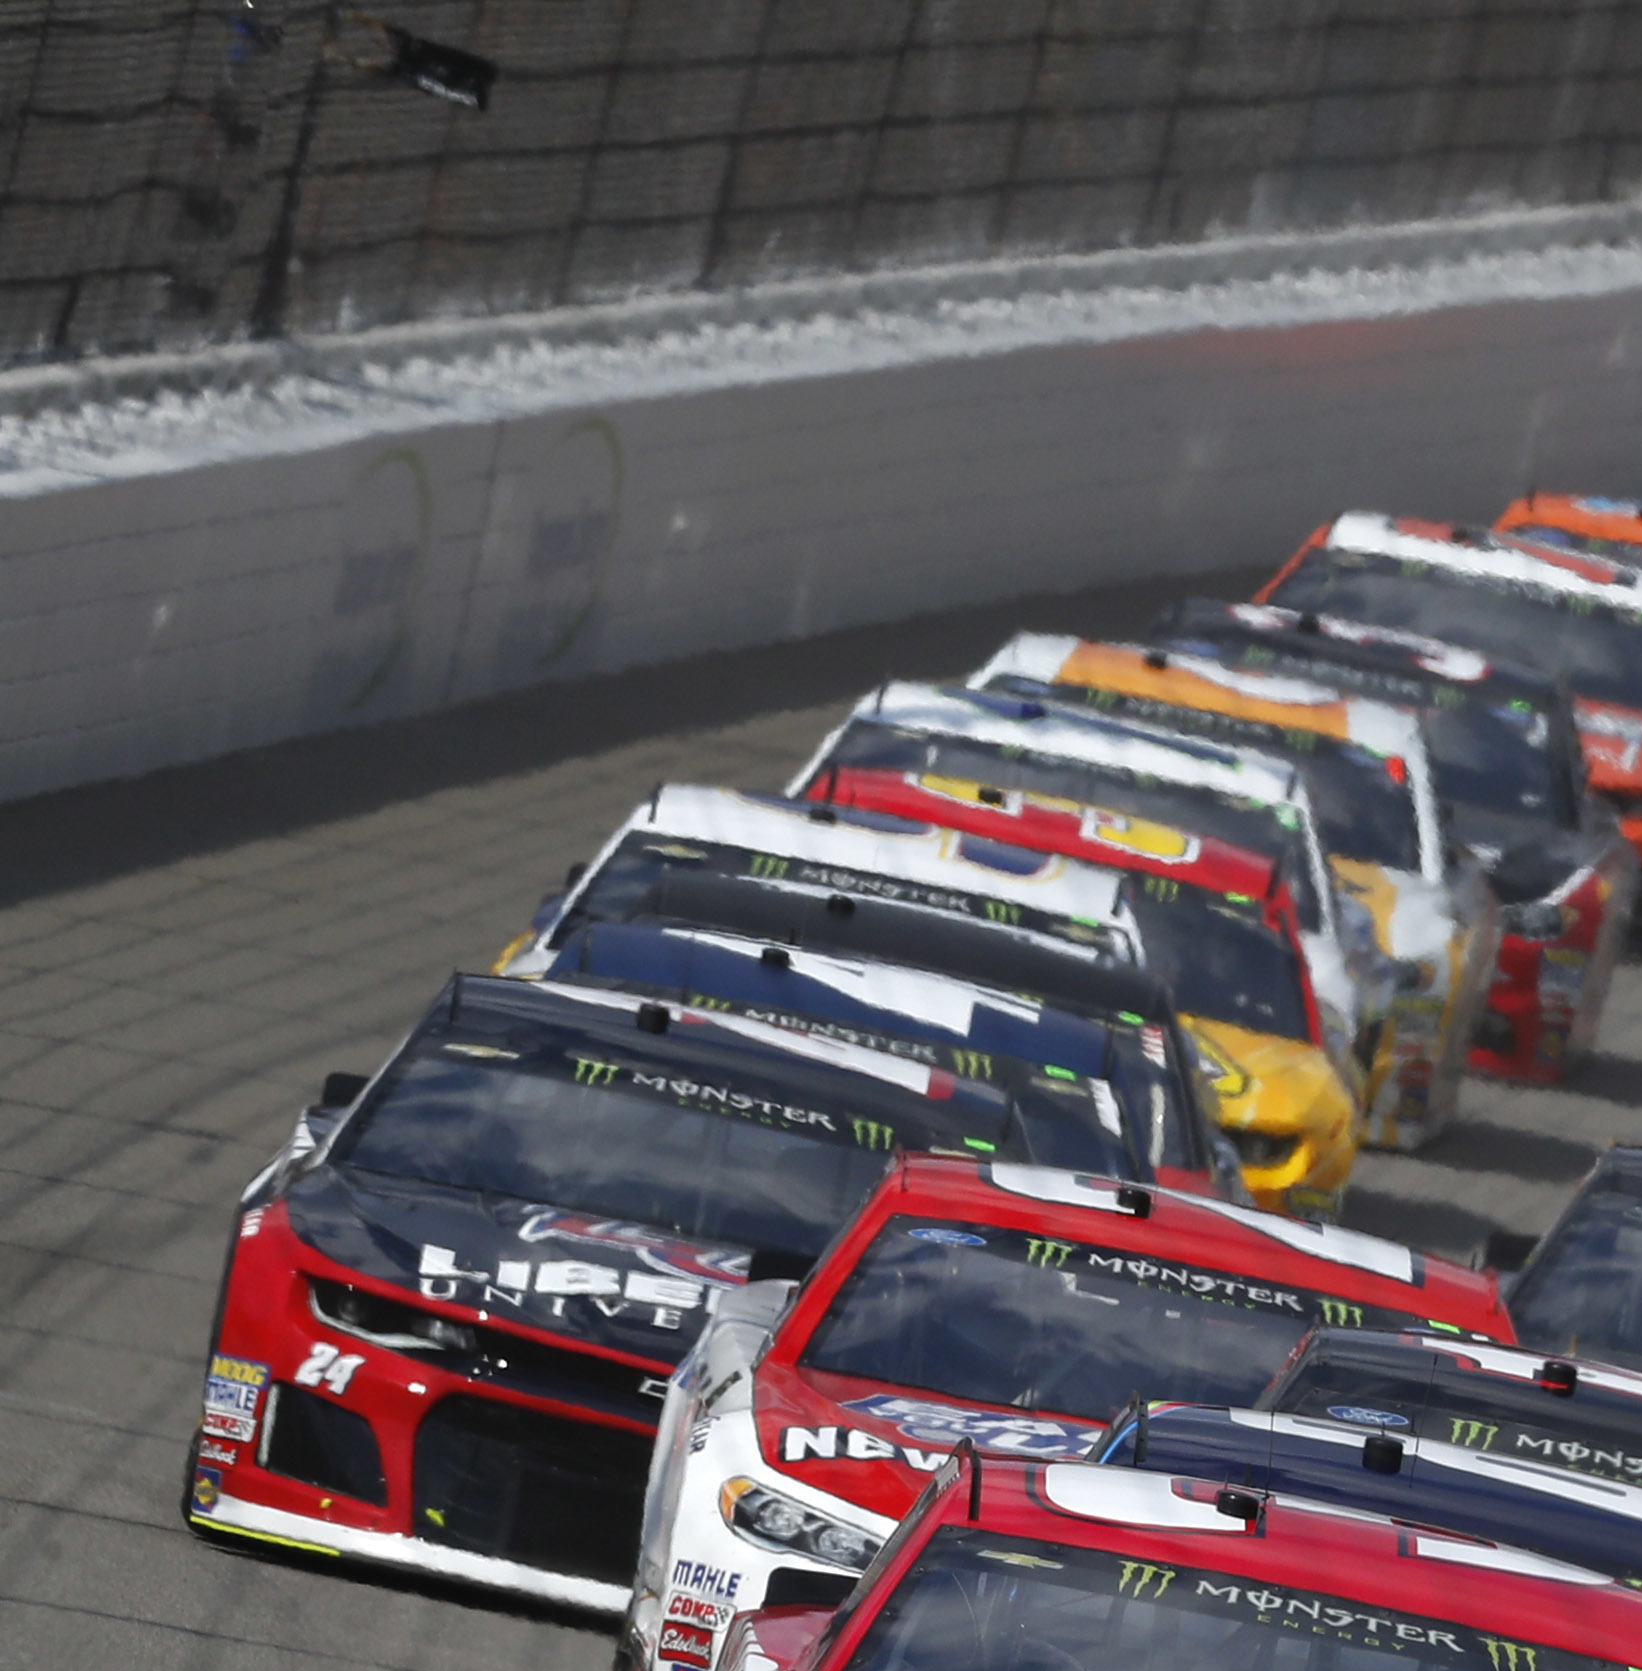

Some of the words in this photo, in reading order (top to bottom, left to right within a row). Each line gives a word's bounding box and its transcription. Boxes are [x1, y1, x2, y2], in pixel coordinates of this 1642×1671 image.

[1087, 1252, 1304, 1312] MONSTER
[293, 1341, 367, 1396] 24
[672, 1559, 741, 1599] MAHLE
[1196, 1579, 1466, 1654] MONSTER
[1256, 1613, 1406, 1651] ENERGY
